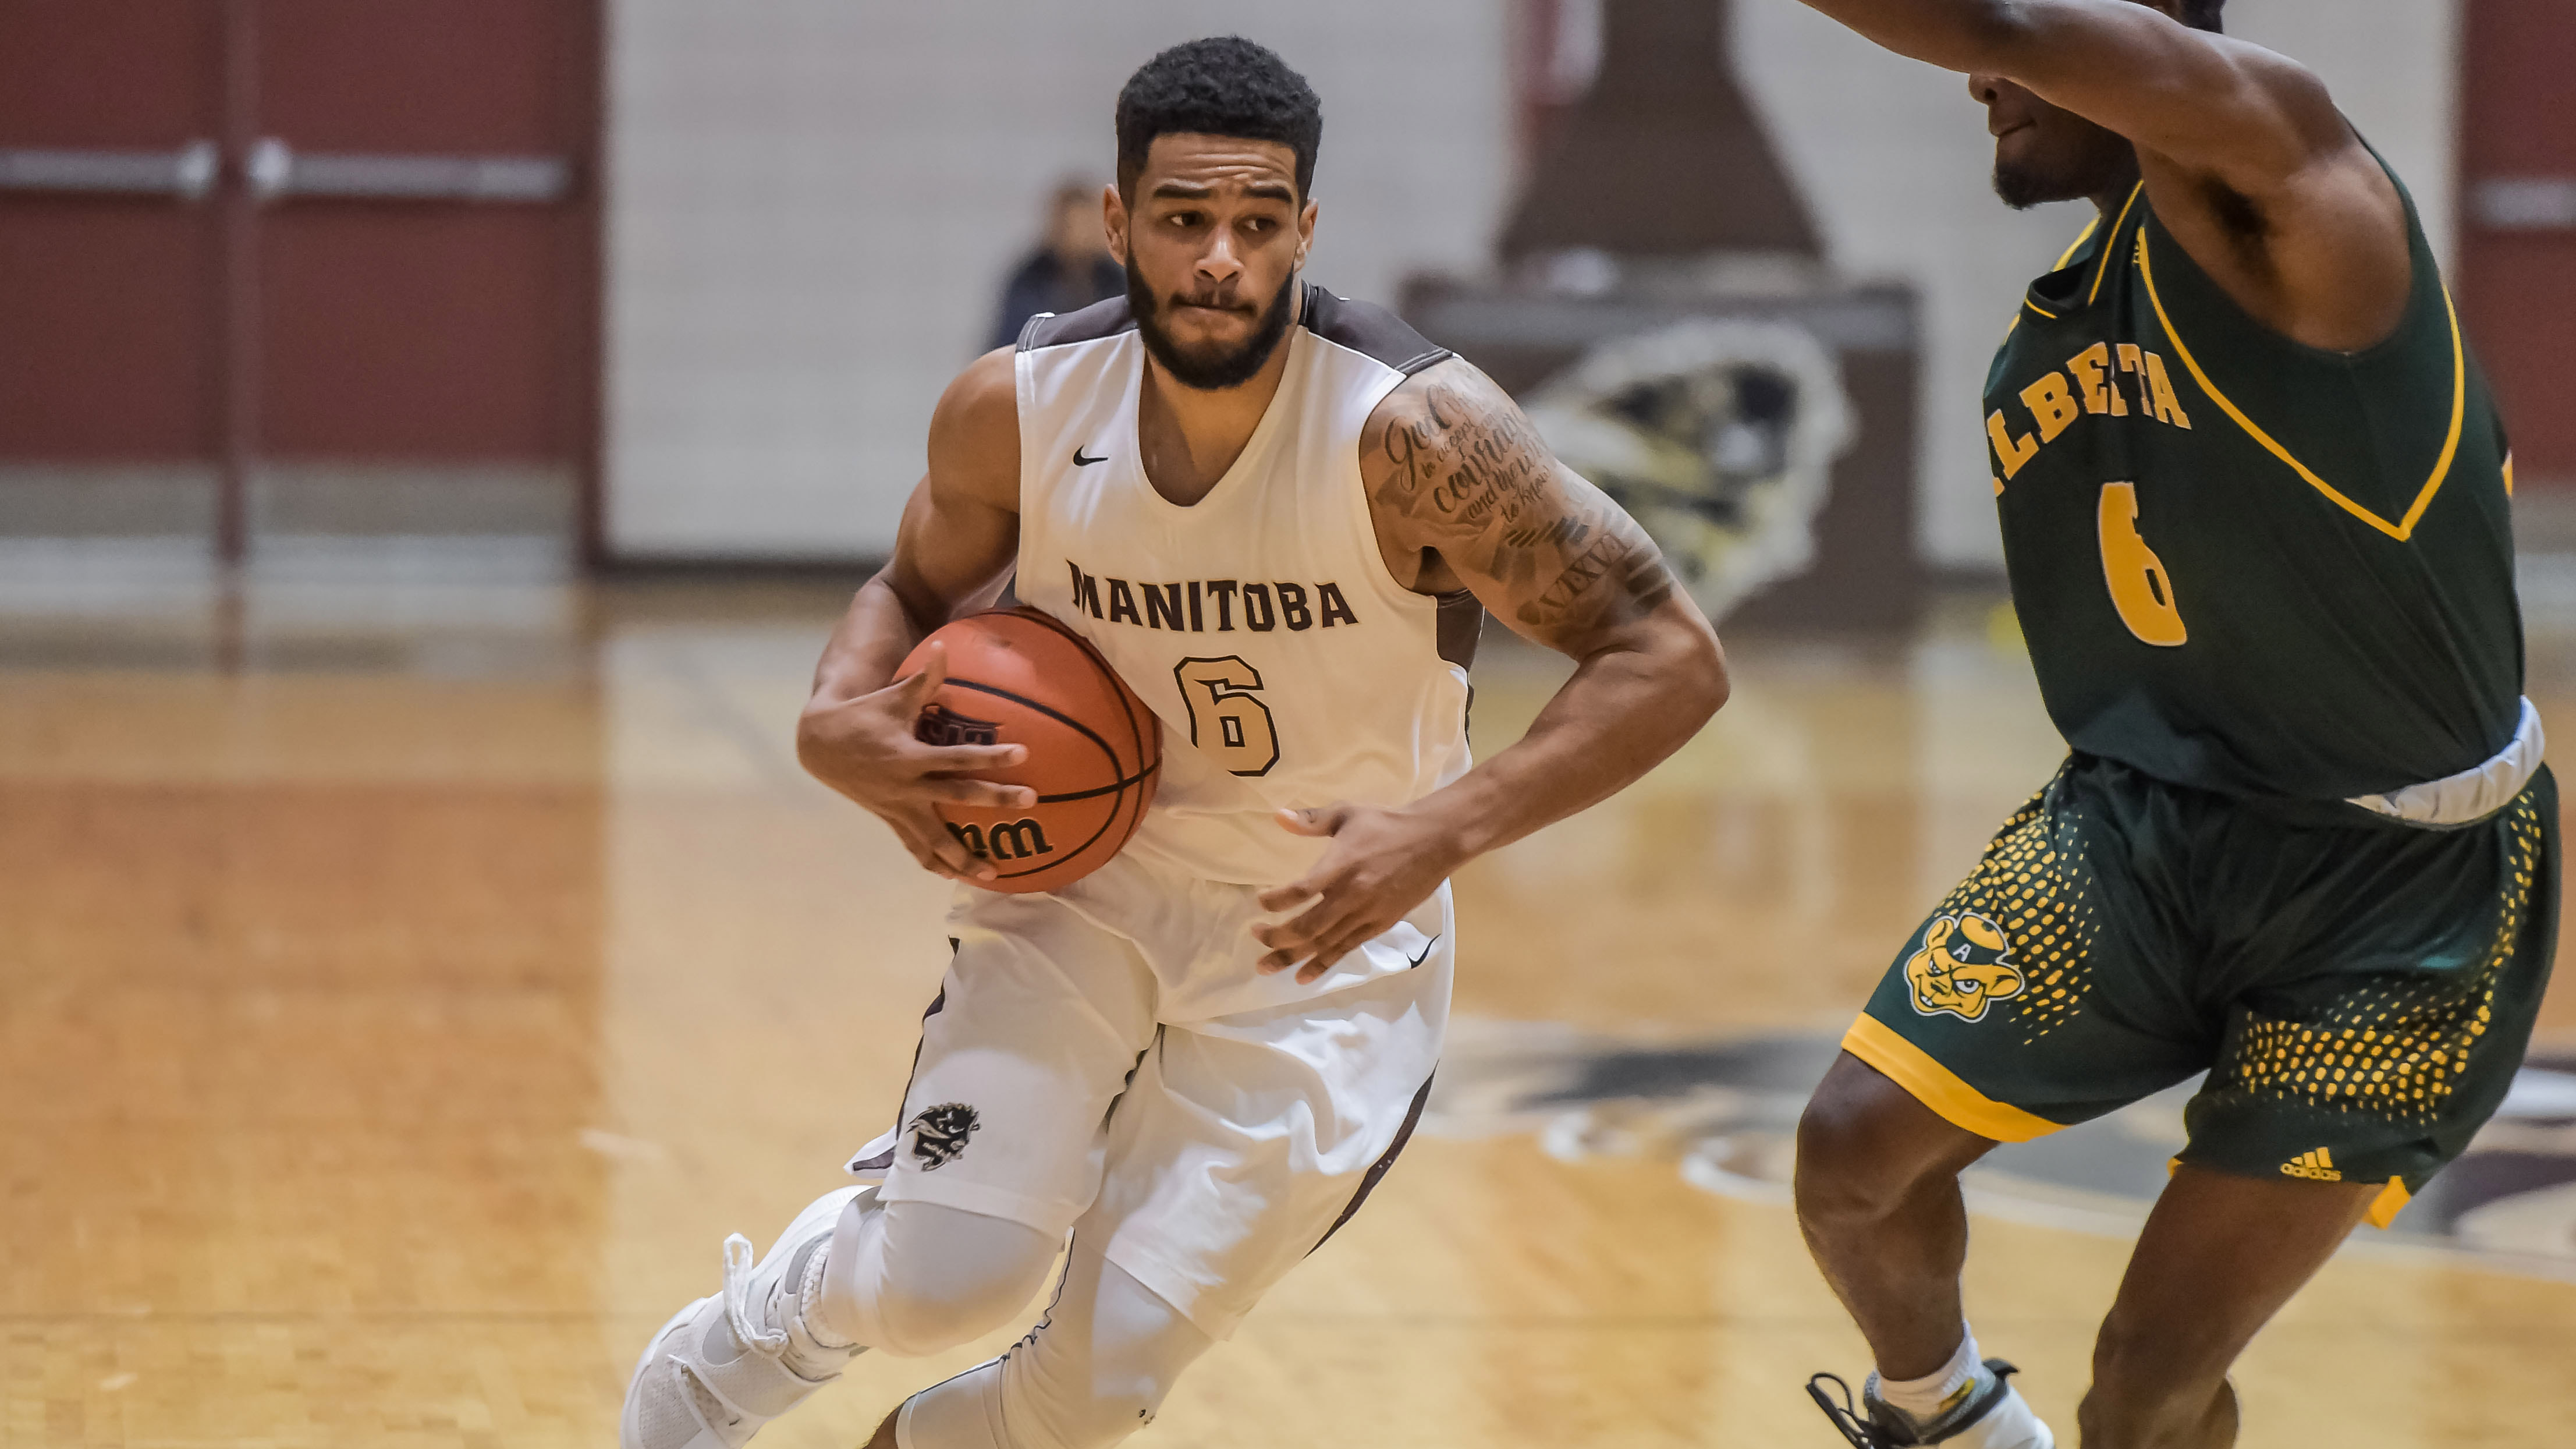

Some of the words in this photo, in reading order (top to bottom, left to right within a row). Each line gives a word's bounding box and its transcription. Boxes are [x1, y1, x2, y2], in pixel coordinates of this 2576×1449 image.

[1066, 558, 1360, 633] MANITOBA
[2098, 480, 2187, 647] 6
[1173, 654, 1280, 777] 6
[1953, 943, 1971, 962] A
[2280, 1163, 2342, 1181] adidas
